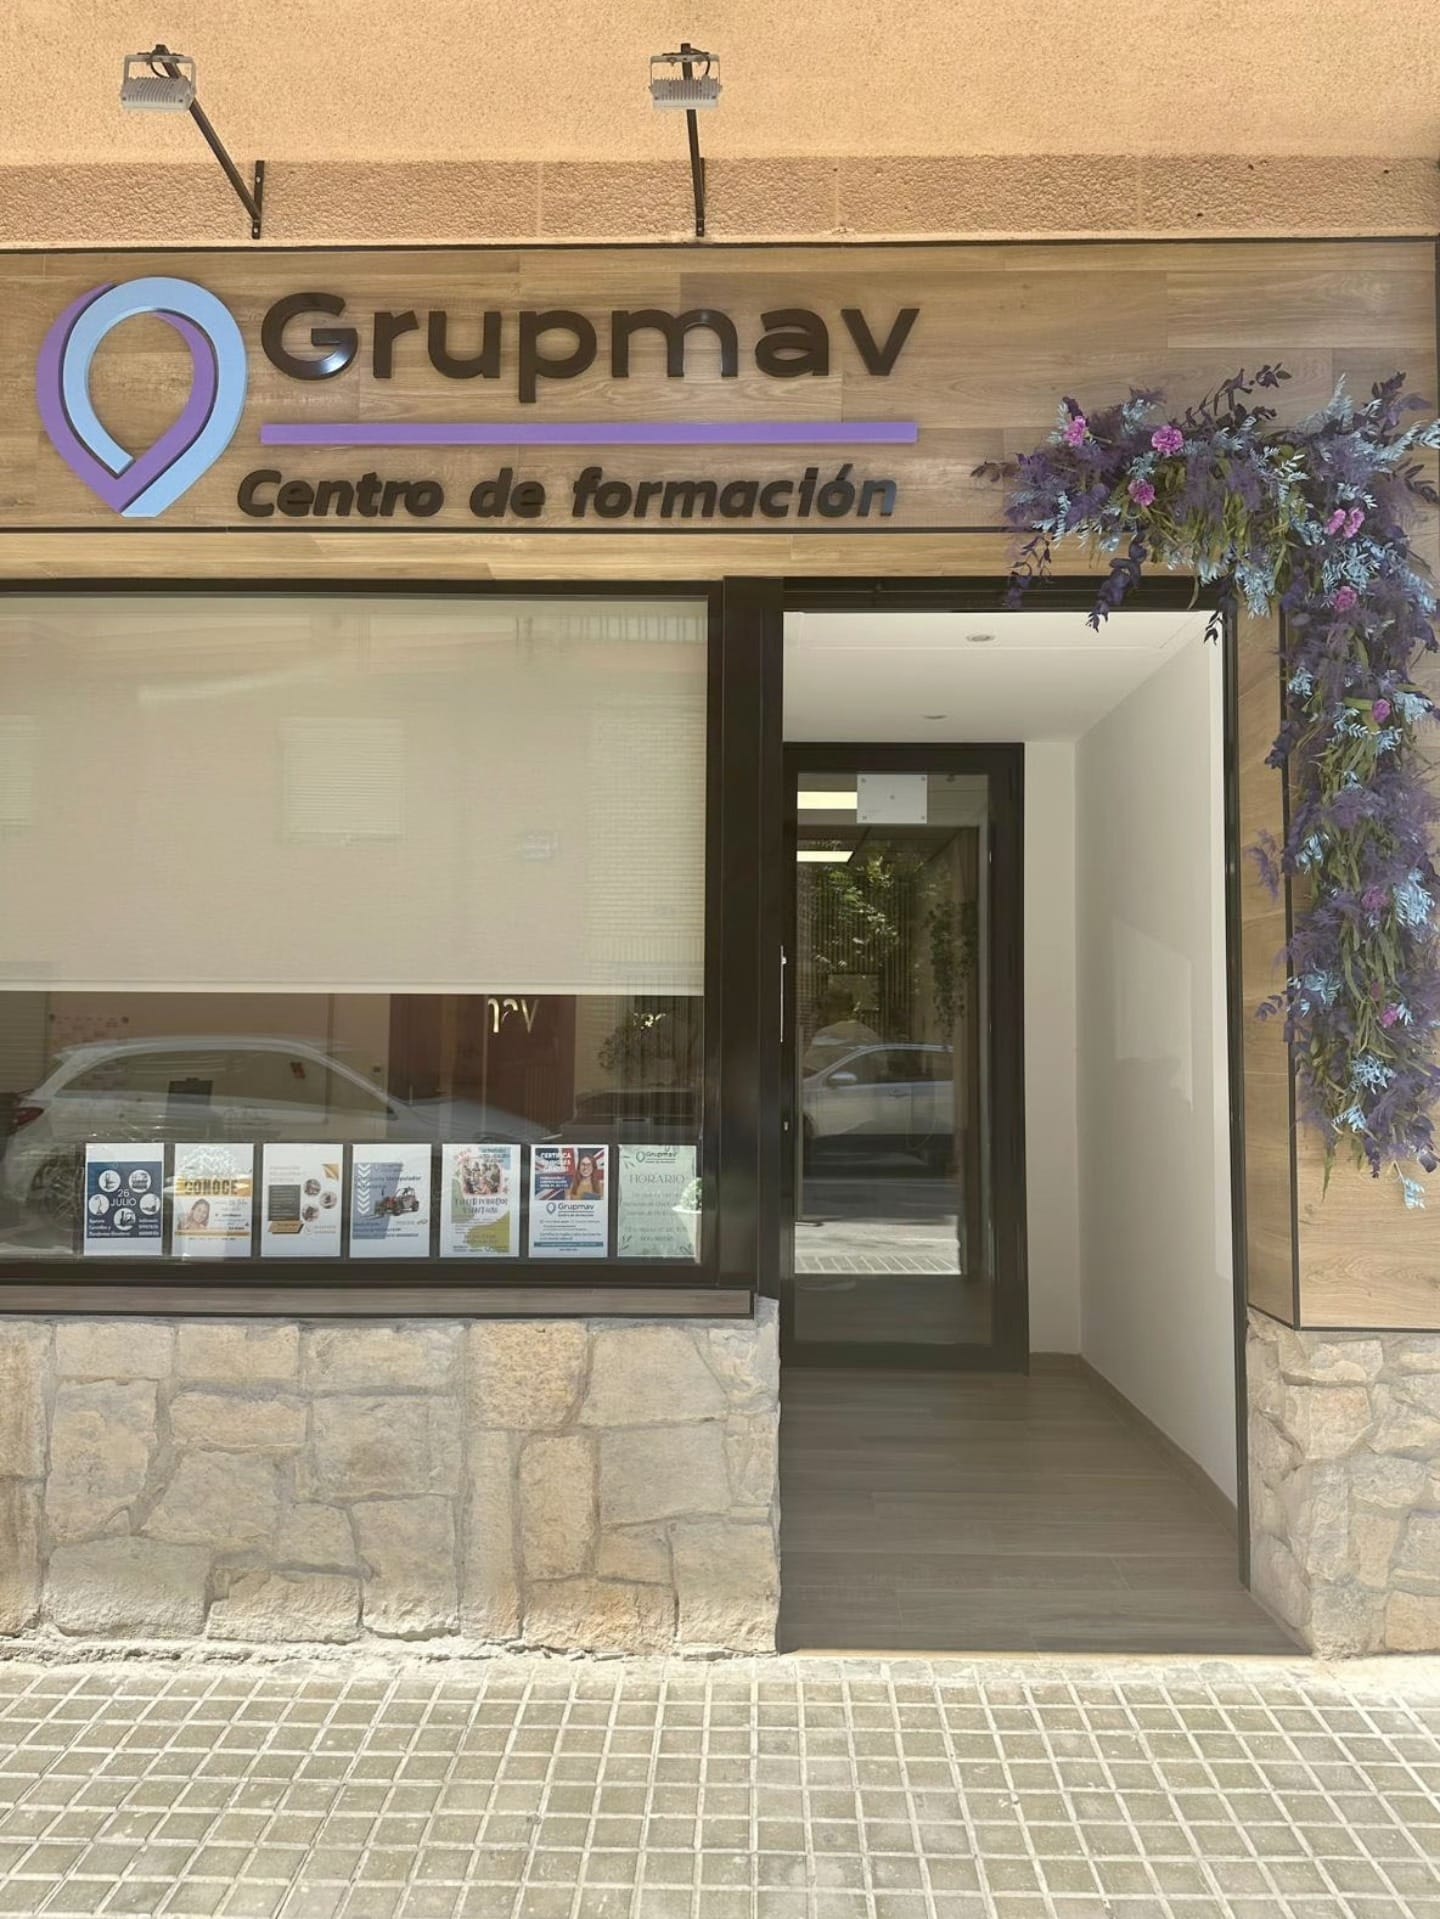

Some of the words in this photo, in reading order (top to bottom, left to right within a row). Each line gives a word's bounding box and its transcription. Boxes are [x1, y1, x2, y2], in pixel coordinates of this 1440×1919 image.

[260, 292, 921, 404] Grupmav
[237, 469, 446, 518] Centro
[470, 467, 546, 518] de
[571, 463, 899, 519] formación
[629, 1174, 686, 1184] HORARIO
[184, 1179, 239, 1195] CONOCE
[117, 1188, 130, 1198] 26
[110, 1197, 137, 1207] JULIO
[557, 1202, 595, 1211] Grupmav
